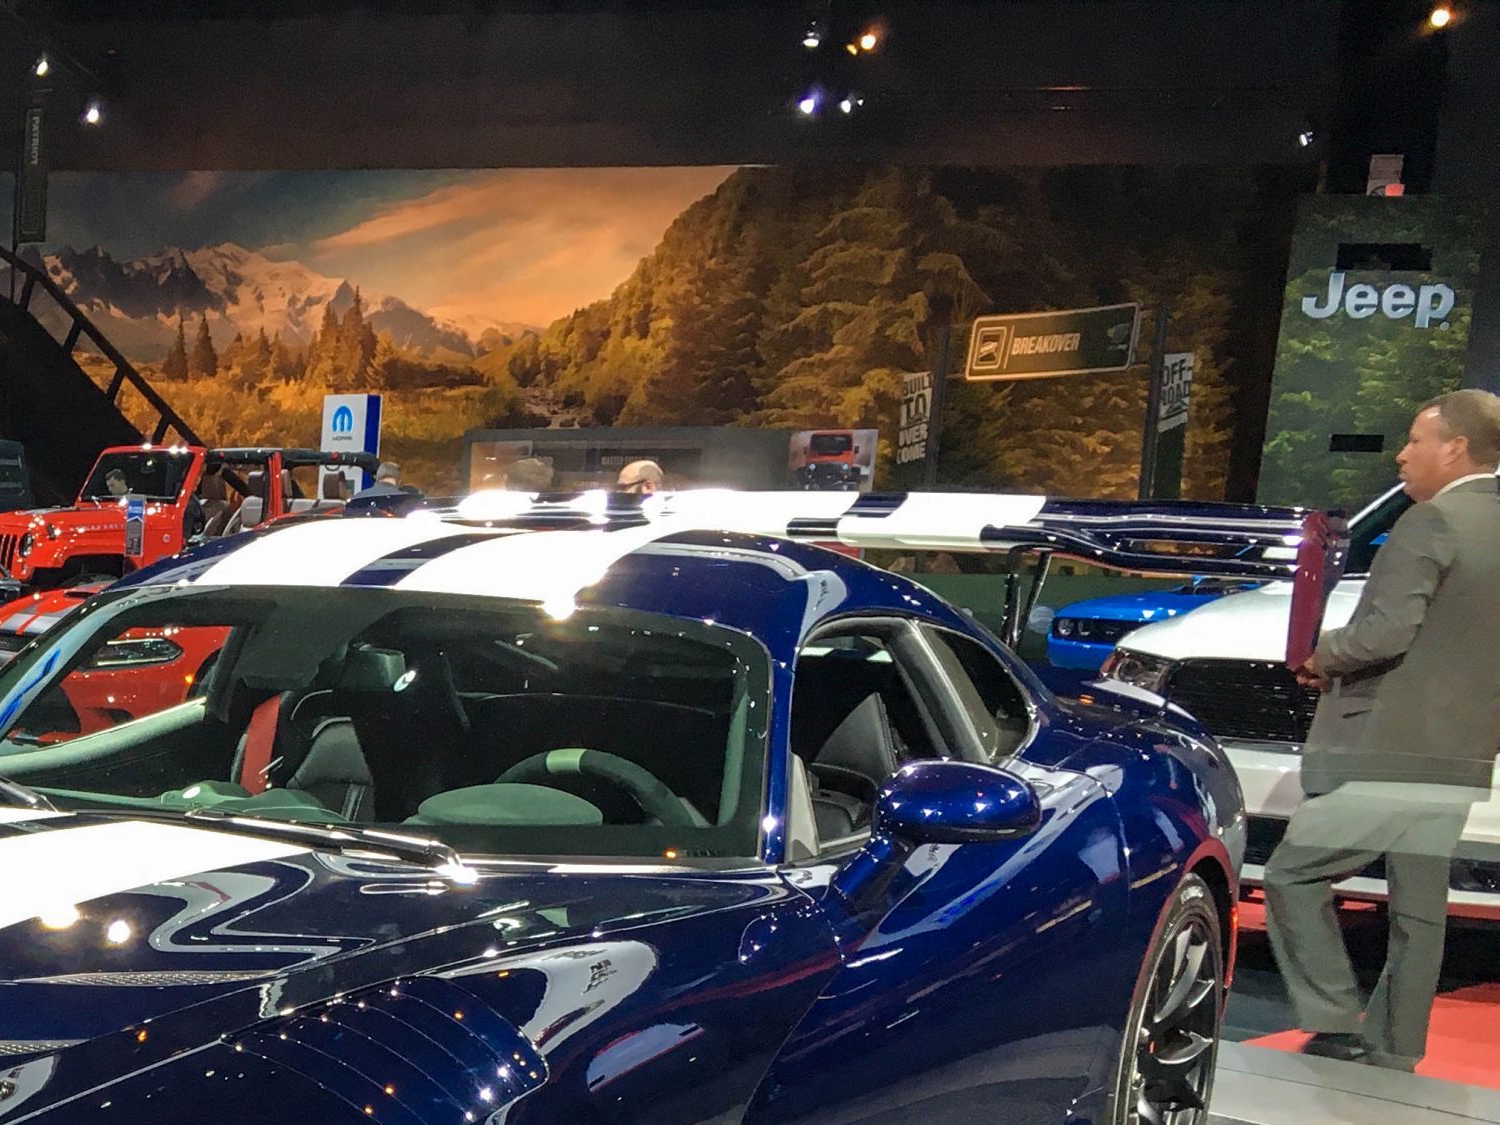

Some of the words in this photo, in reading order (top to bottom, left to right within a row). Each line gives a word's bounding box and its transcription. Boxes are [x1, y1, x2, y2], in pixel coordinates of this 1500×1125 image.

[30, 116, 40, 166] PATRIOT
[1301, 272, 1455, 329] Jeep
[1011, 332, 1081, 355] BREAKOVER
